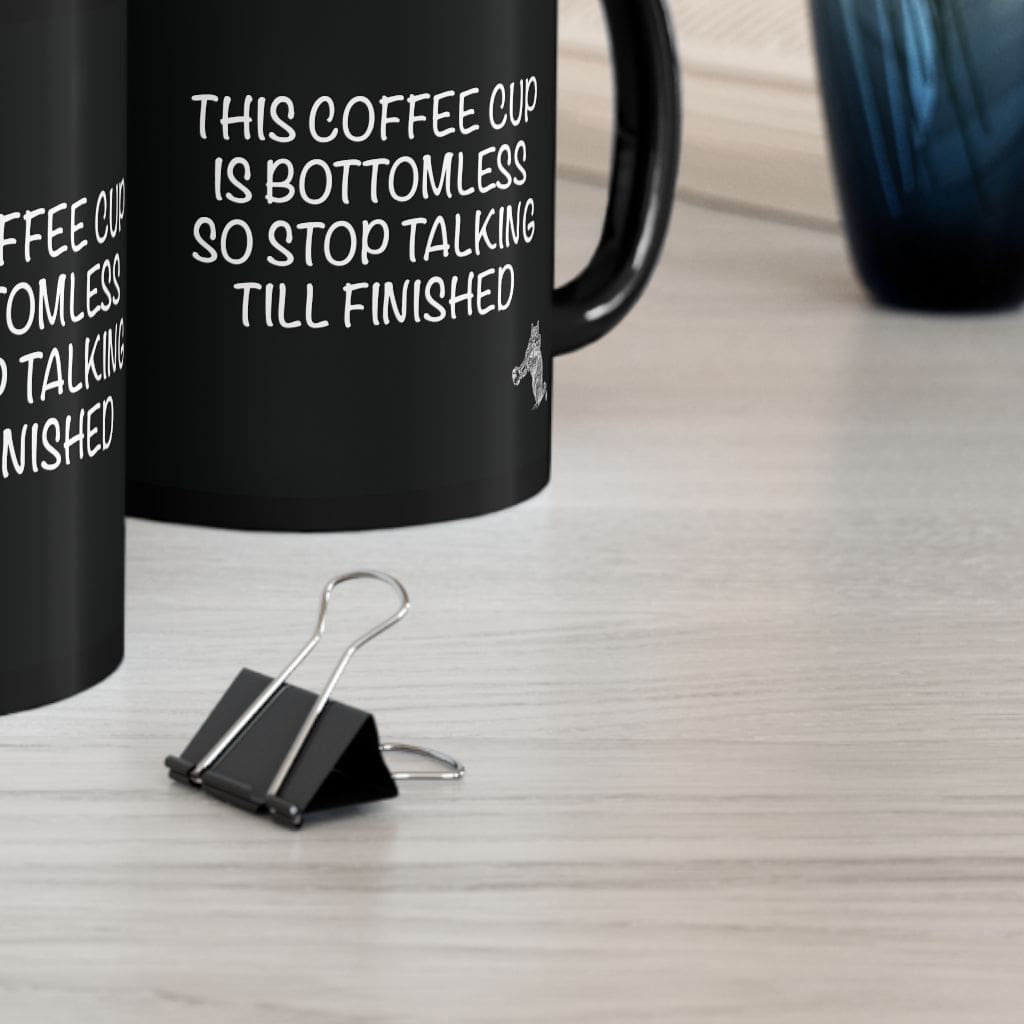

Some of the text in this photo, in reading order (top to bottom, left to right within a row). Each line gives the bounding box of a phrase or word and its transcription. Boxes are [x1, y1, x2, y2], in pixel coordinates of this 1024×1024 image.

[191, 75, 538, 143] THIS COFFEE CUP
[214, 139, 527, 205] IS BOTTOMLESS
[94, 177, 126, 245] CUP
[191, 197, 536, 267] SO STOP TALKING
[233, 263, 515, 329] TILL FINISHED
[18, 316, 125, 405] TALKING
